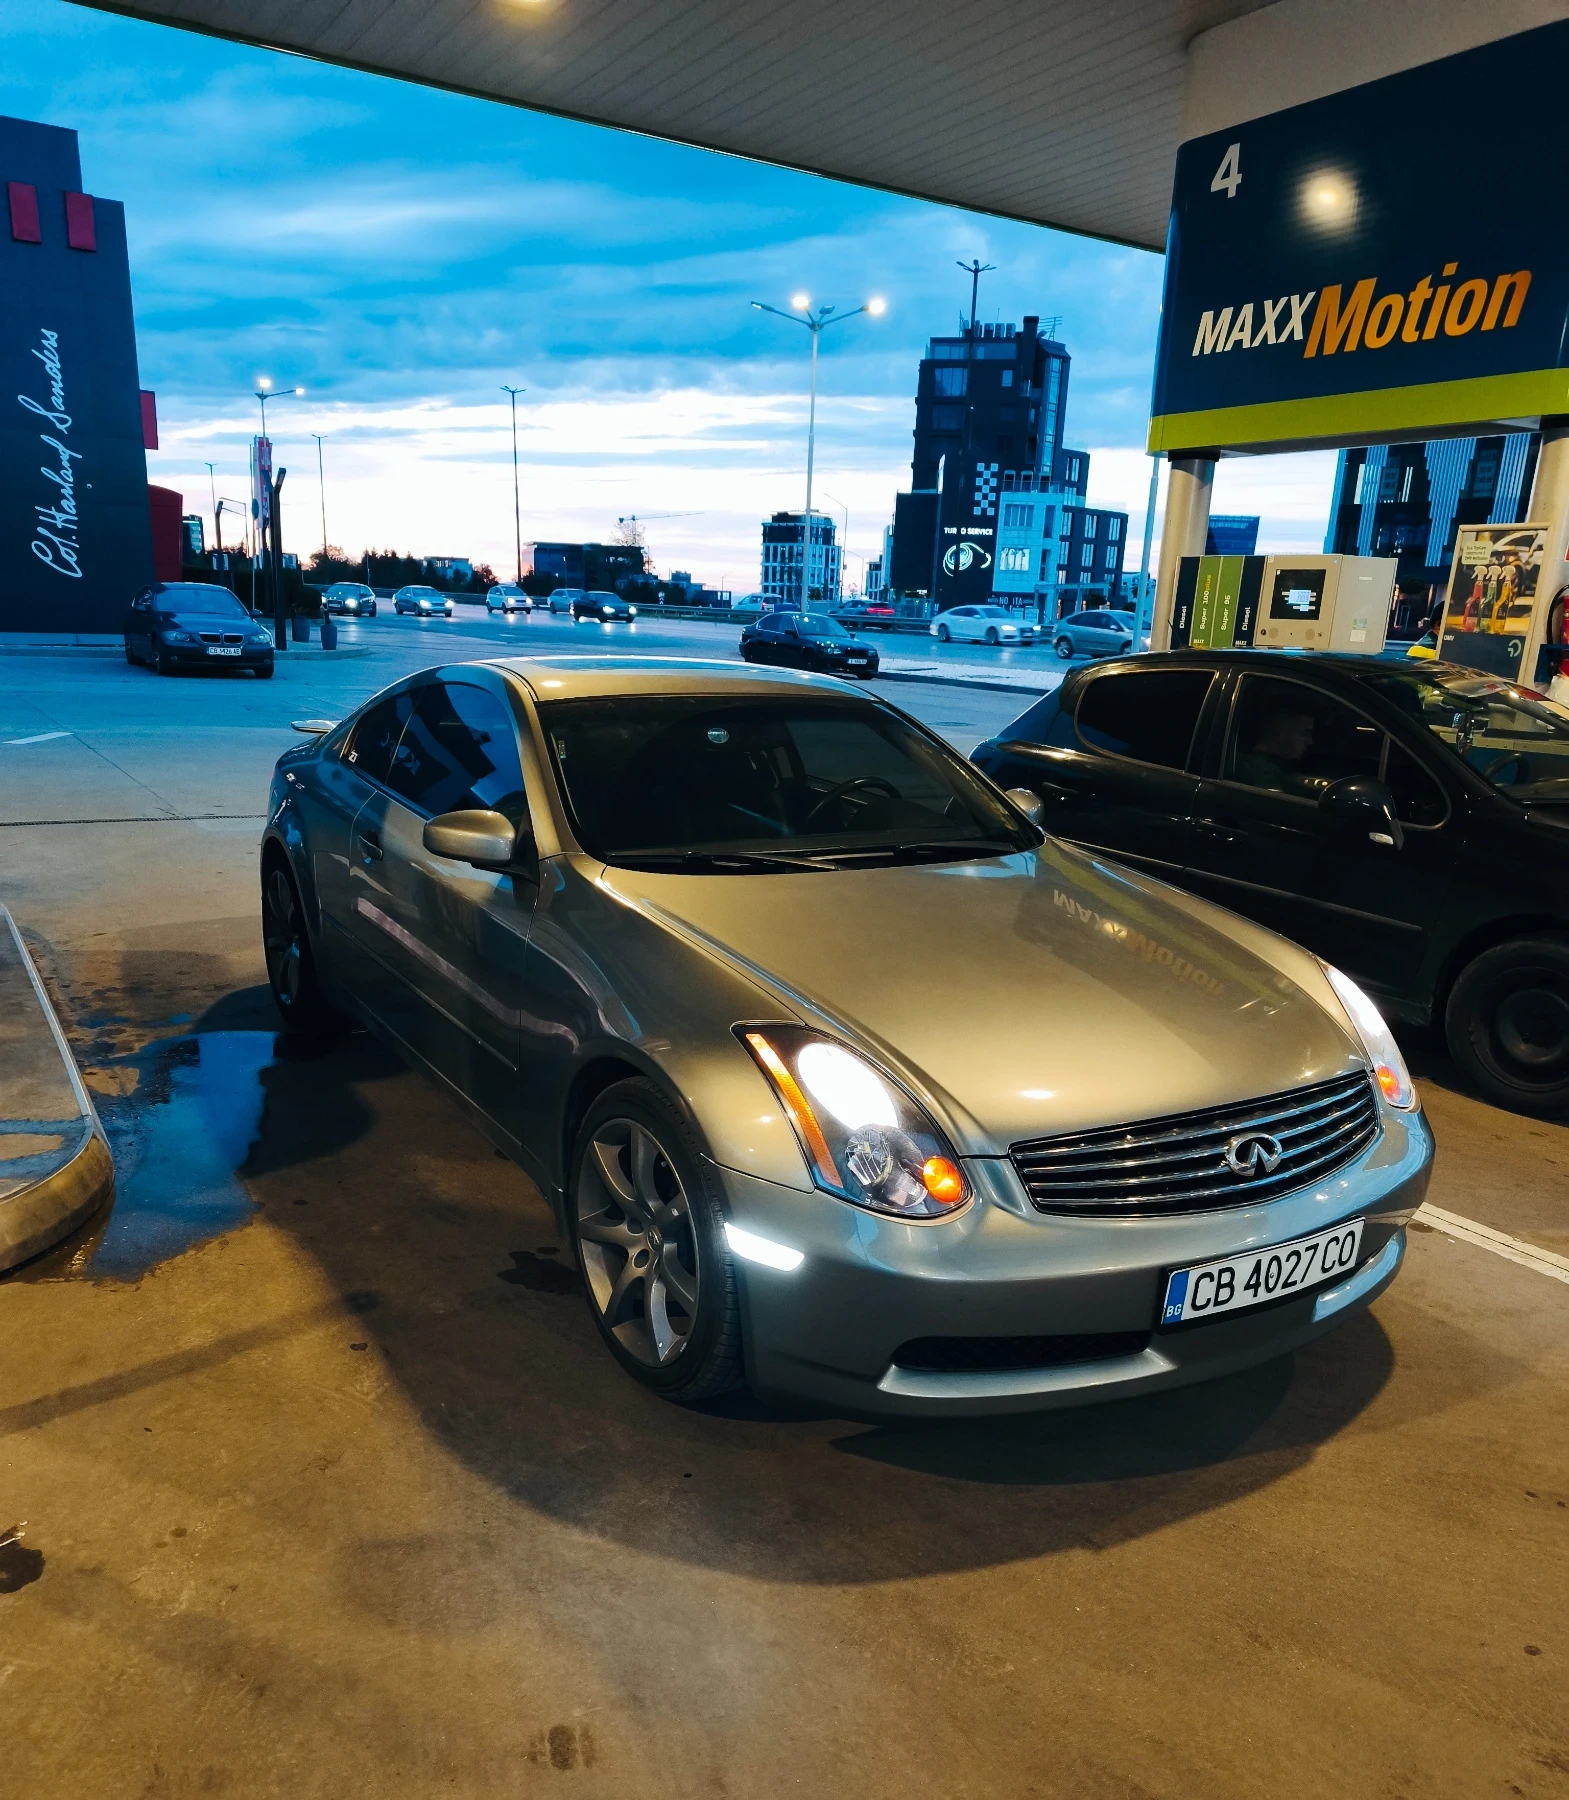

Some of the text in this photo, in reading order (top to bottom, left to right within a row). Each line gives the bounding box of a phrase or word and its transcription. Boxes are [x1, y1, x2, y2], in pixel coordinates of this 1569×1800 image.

[1210, 142, 1242, 198] 4
[18, 328, 72, 434] Sanders
[944, 527, 993, 536] TURO SERVICE
[1179, 606, 1187, 629] Diesel
[1200, 608, 1208, 630] Super
[1220, 608, 1229, 630] Super
[1241, 606, 1251, 630] Diesel
[1190, 1229, 1356, 1311] CB 4027 CO
[1166, 1304, 1183, 1318] BG
